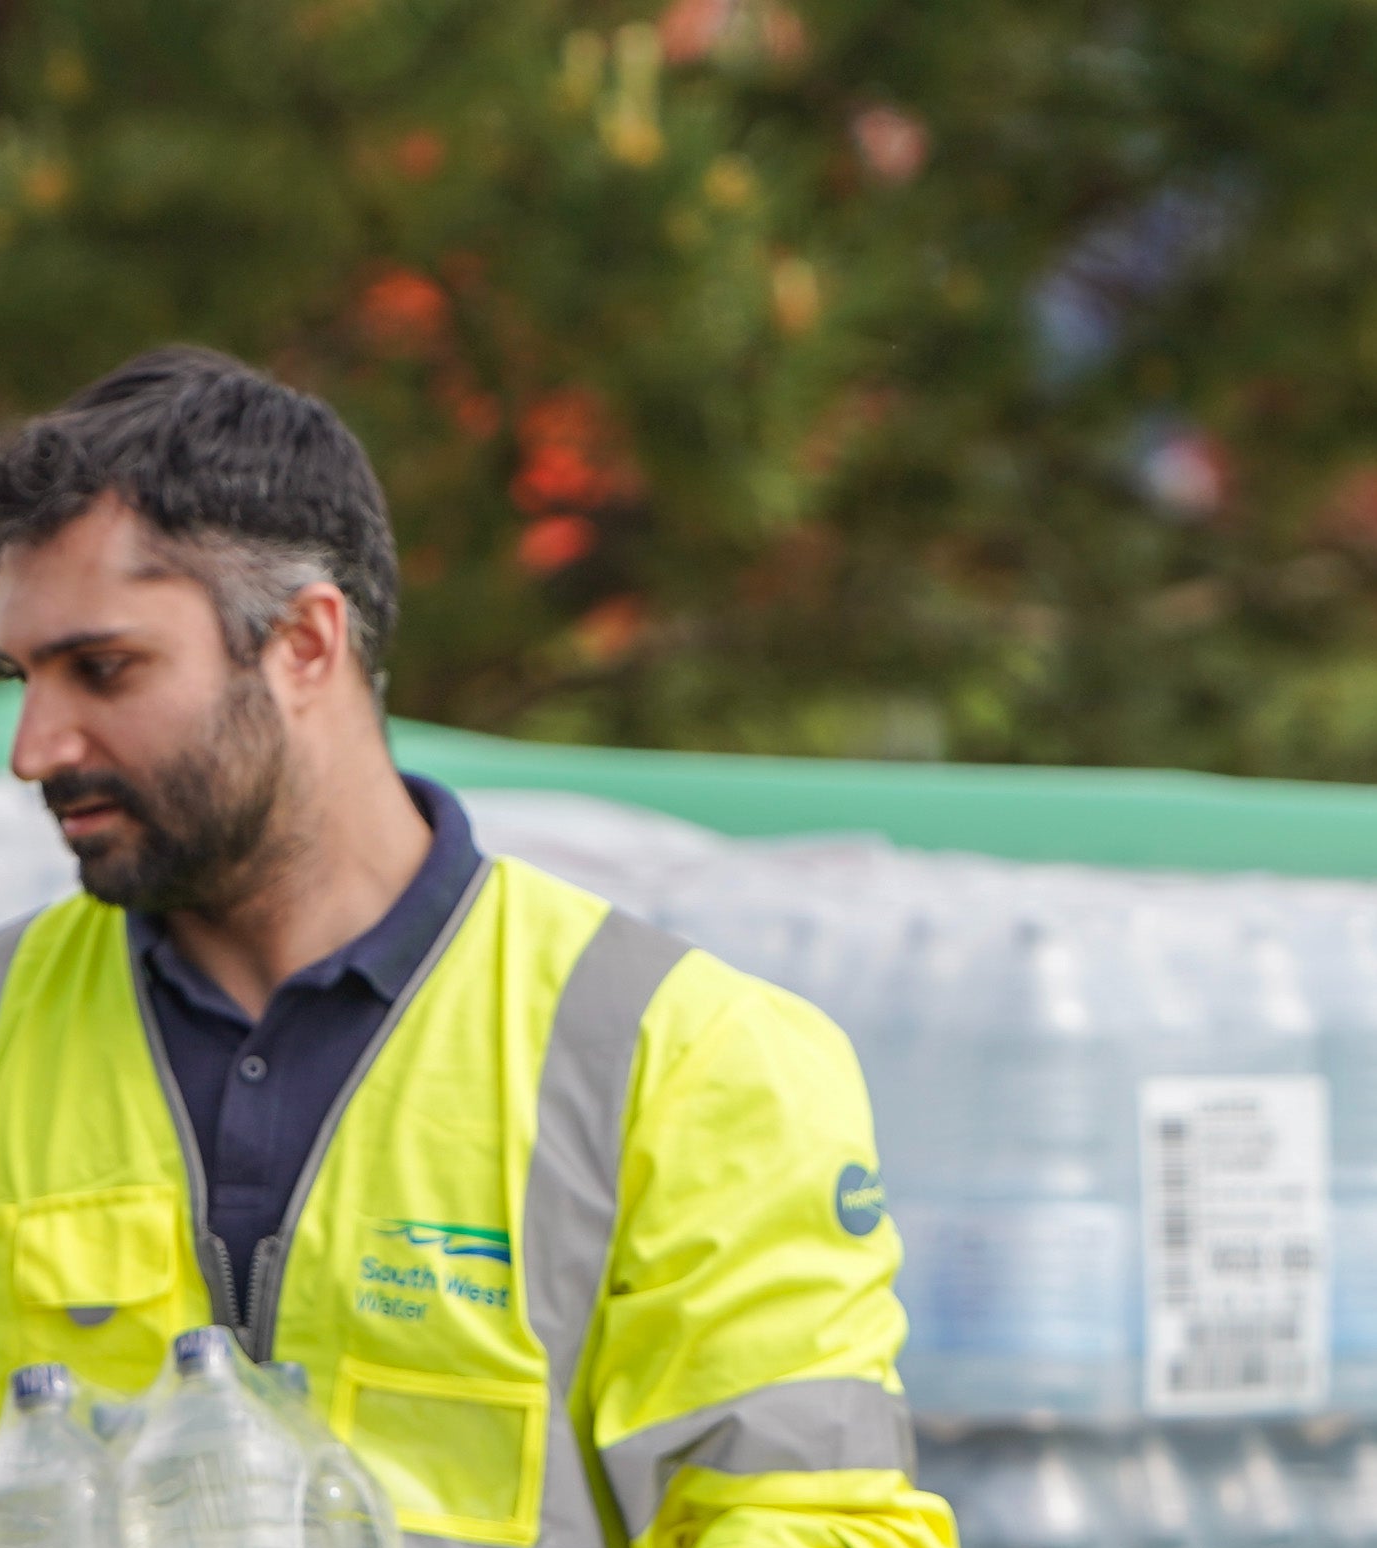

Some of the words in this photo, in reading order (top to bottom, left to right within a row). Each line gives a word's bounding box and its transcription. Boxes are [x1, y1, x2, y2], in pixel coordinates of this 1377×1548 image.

[354, 1287, 429, 1322] Water
[360, 1256, 438, 1292] South
[446, 1273, 510, 1310] West
